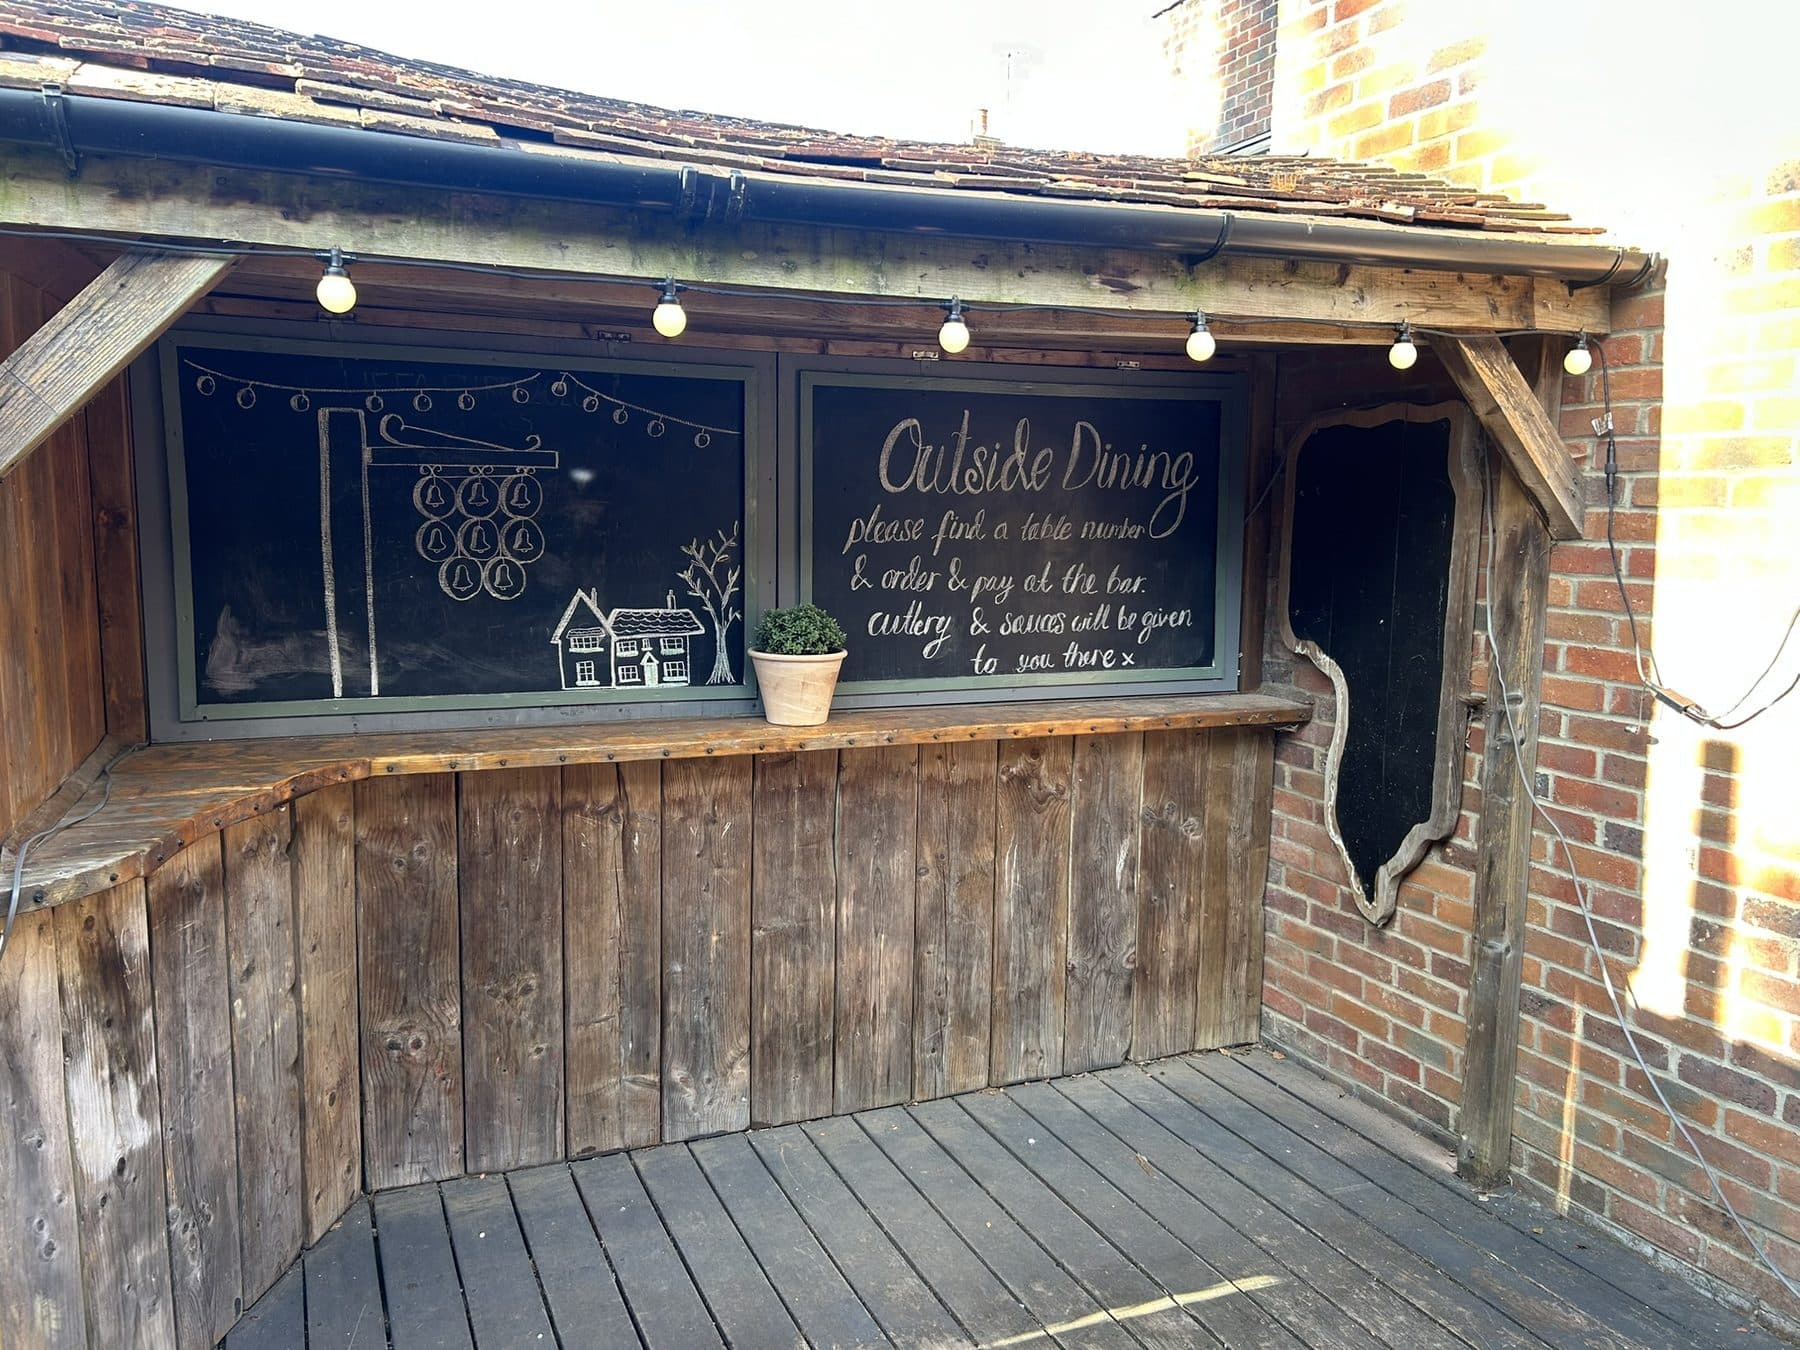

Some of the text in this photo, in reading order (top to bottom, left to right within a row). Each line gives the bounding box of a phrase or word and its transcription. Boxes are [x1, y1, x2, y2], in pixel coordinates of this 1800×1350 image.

[879, 409, 1200, 540] Outside Dining
[842, 503, 1146, 556] please find a table number
[850, 553, 1148, 604] & order & pay at the bar.
[868, 600, 952, 659] cutlery
[970, 606, 991, 636] &
[1071, 604, 1110, 632] will
[1117, 604, 1136, 632] be
[1137, 607, 1192, 645] given
[969, 643, 998, 675] to
[1015, 653, 1055, 673] you
[1062, 641, 1117, 668] there
